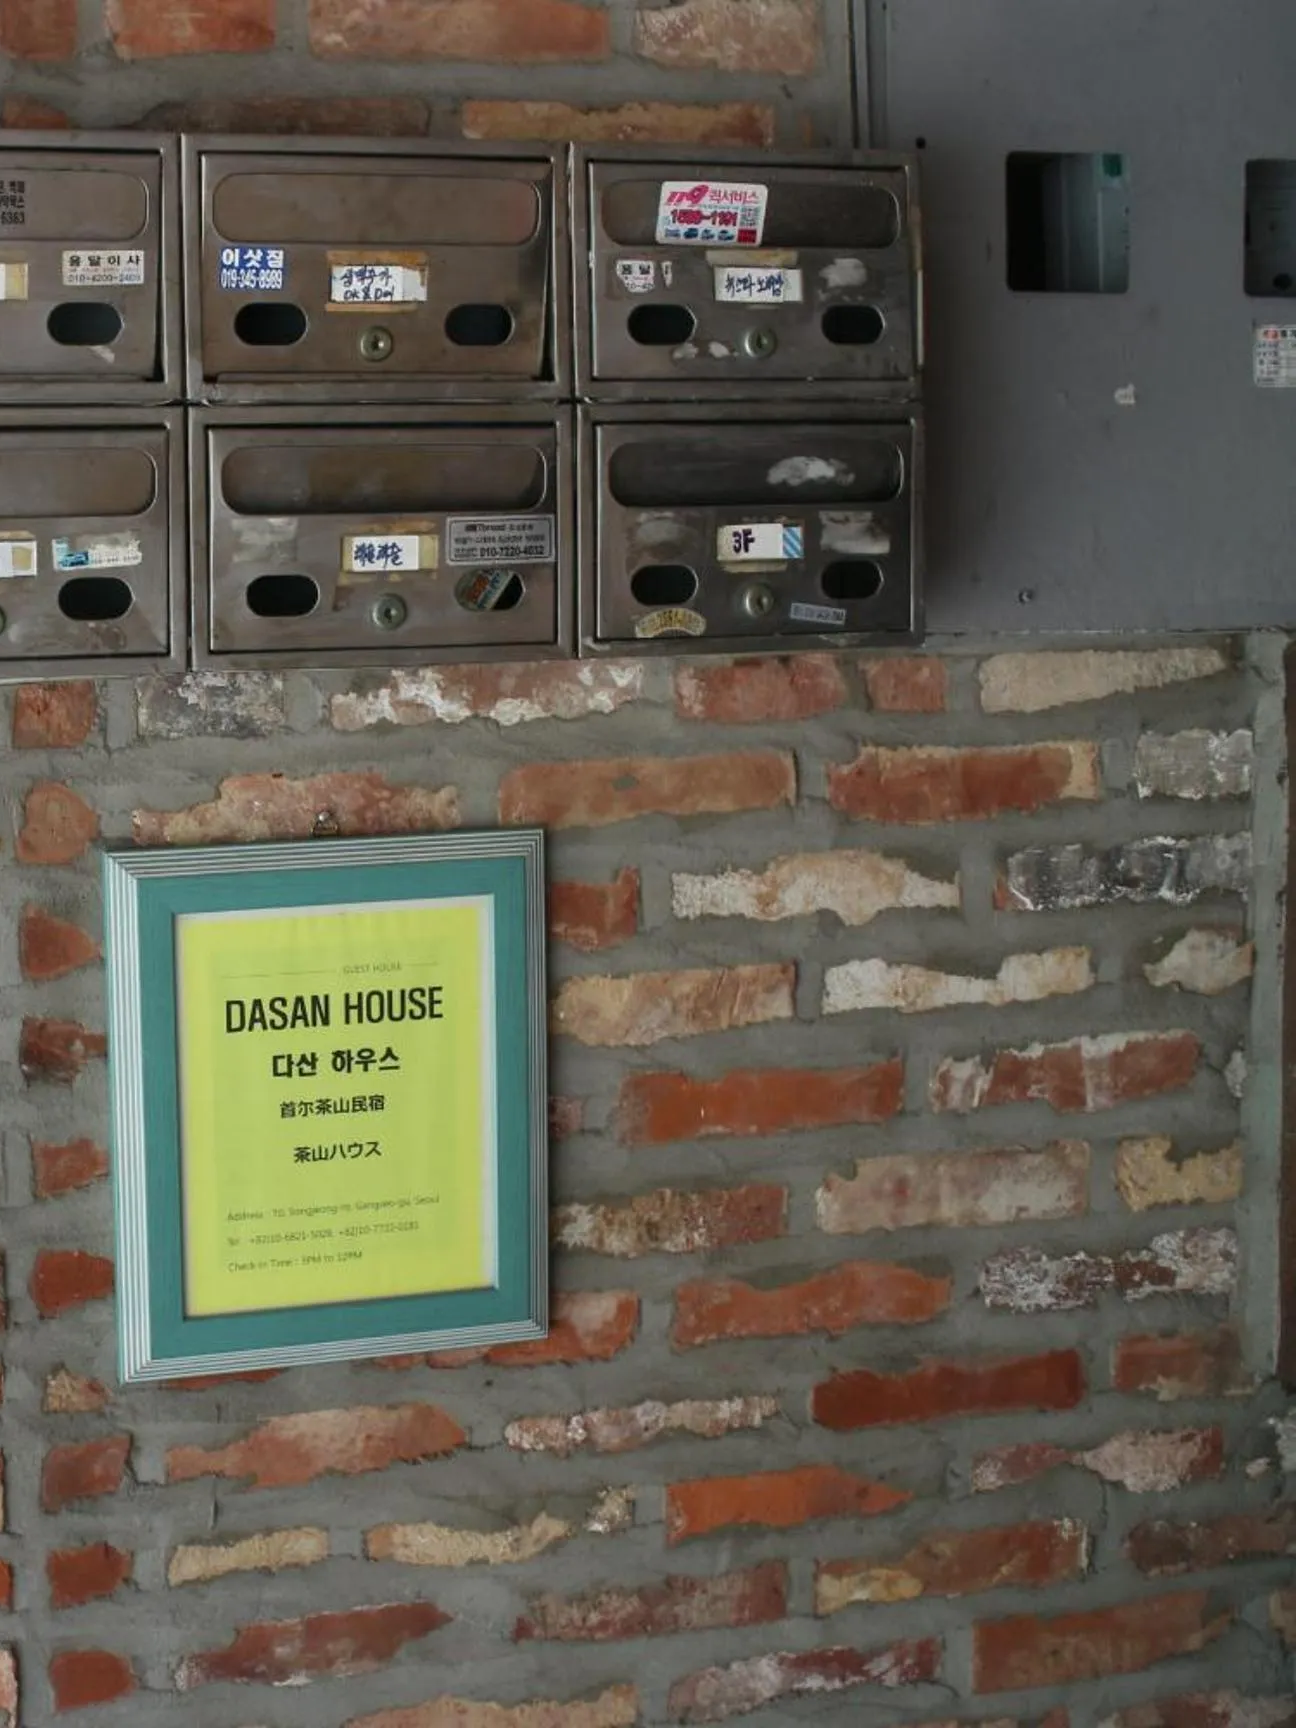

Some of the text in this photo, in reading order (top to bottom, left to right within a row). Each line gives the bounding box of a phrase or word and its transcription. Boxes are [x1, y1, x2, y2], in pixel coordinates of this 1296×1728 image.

[221, 248, 284, 268] 이삿짐
[732, 529, 755, 553] 3F
[225, 986, 444, 1034] DASAN HOUSE
[272, 1047, 401, 1078] 다산 하우스
[280, 1094, 386, 1119] 首尔茶山民宿
[294, 1141, 382, 1164] 茶山ハウス
